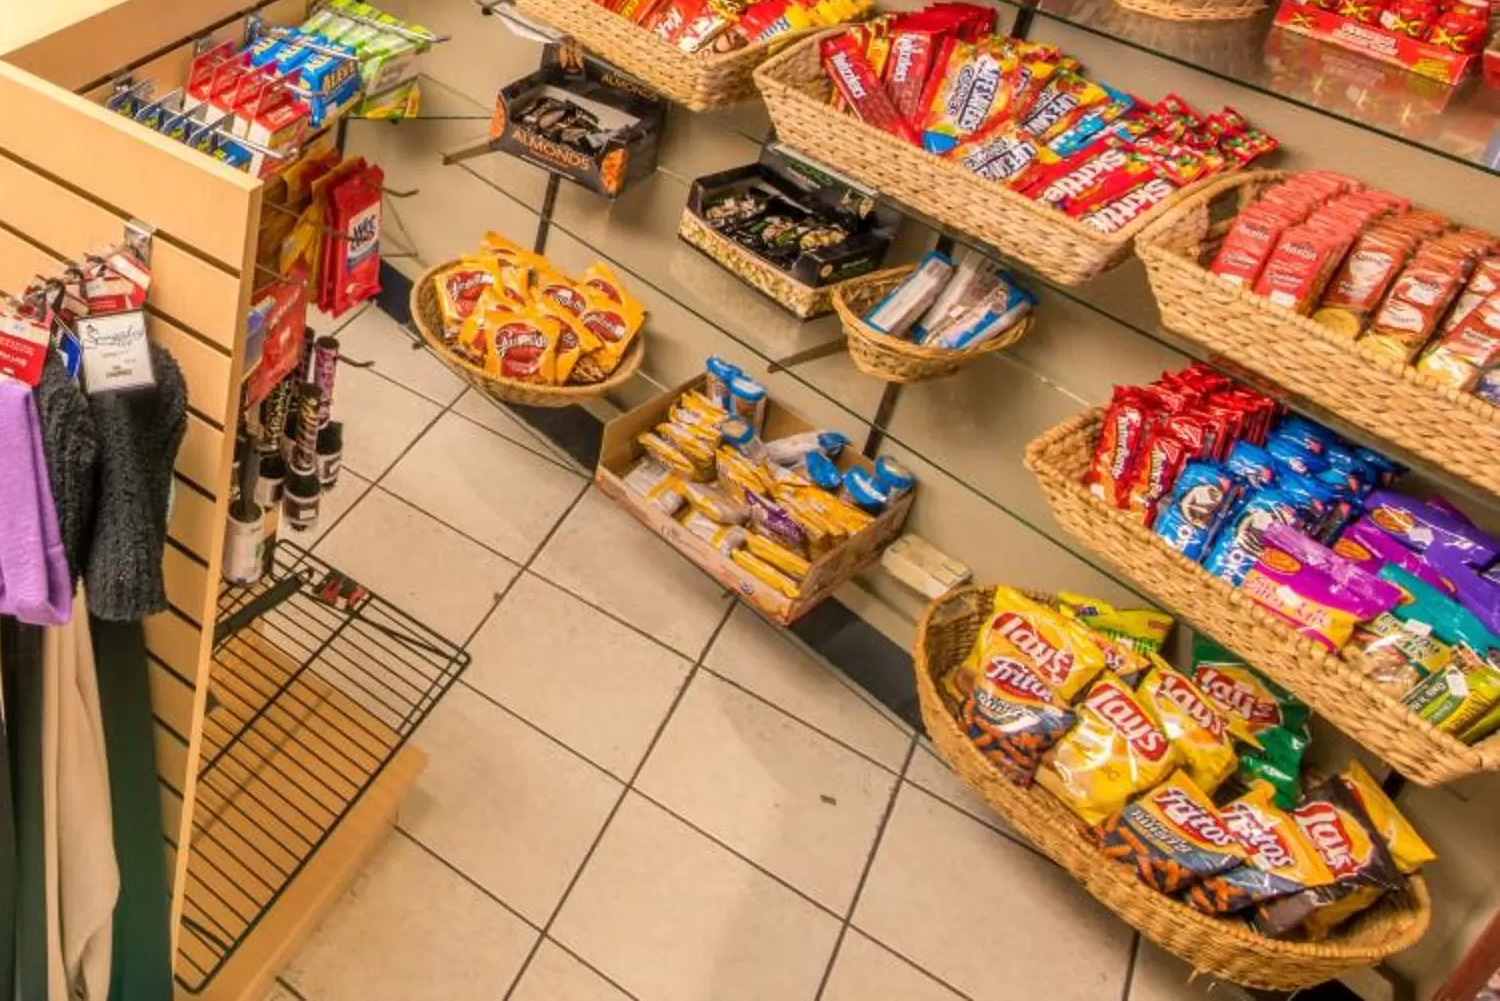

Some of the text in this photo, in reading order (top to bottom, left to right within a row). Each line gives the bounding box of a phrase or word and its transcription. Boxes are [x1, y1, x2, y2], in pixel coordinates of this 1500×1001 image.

[602, 73, 653, 95] ALMOND
[1079, 177, 1175, 234] Skittl
[1154, 788, 1236, 847] Fritos
